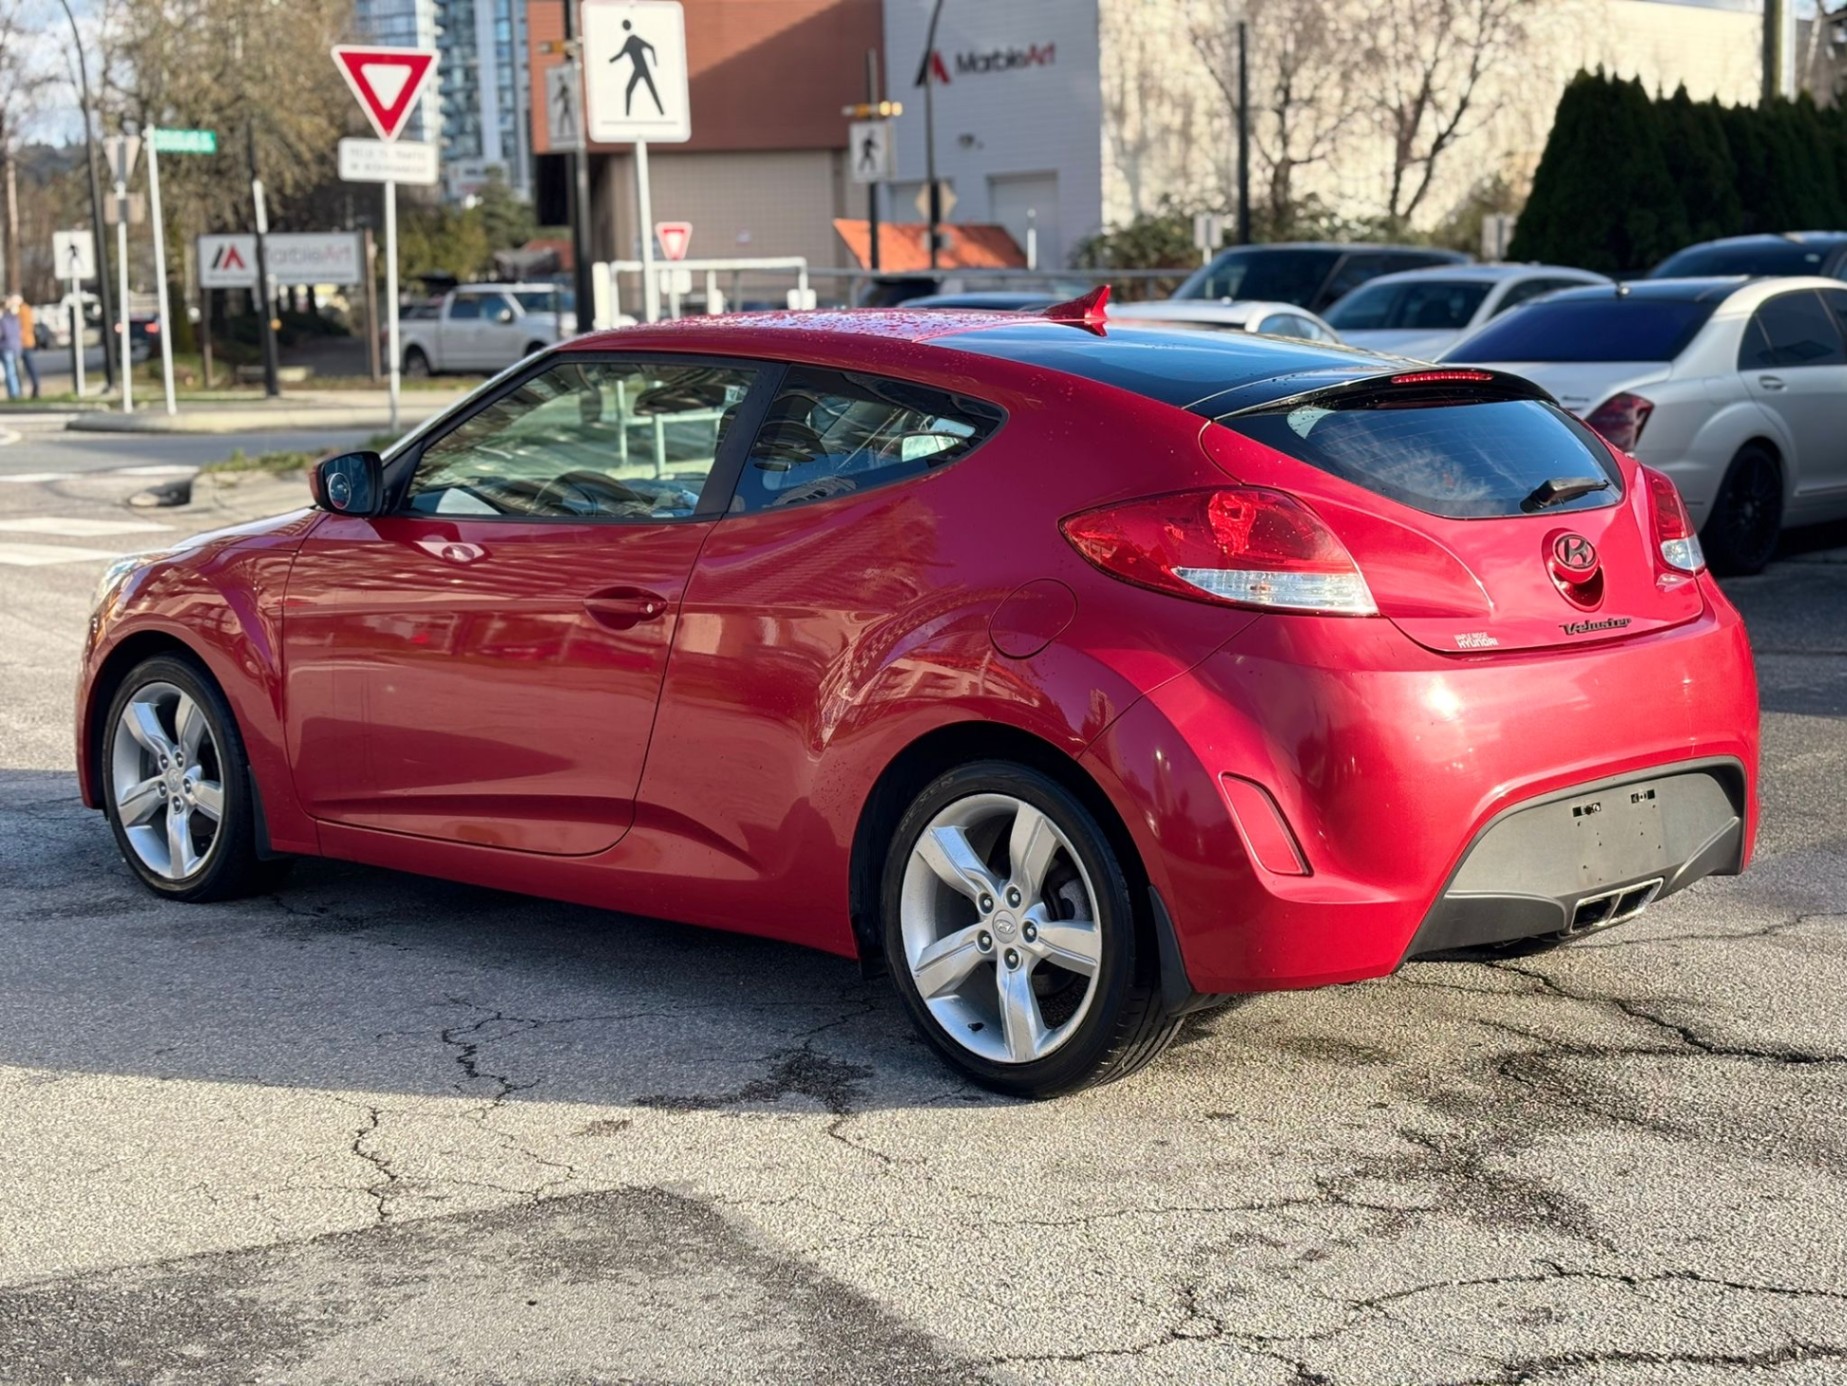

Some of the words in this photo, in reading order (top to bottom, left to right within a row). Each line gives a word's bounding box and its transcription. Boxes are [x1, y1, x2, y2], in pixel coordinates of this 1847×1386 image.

[263, 243, 353, 266] arbleArt
[1558, 617, 1632, 636] Veloster
[1456, 637, 1500, 649] HYUNDAI
